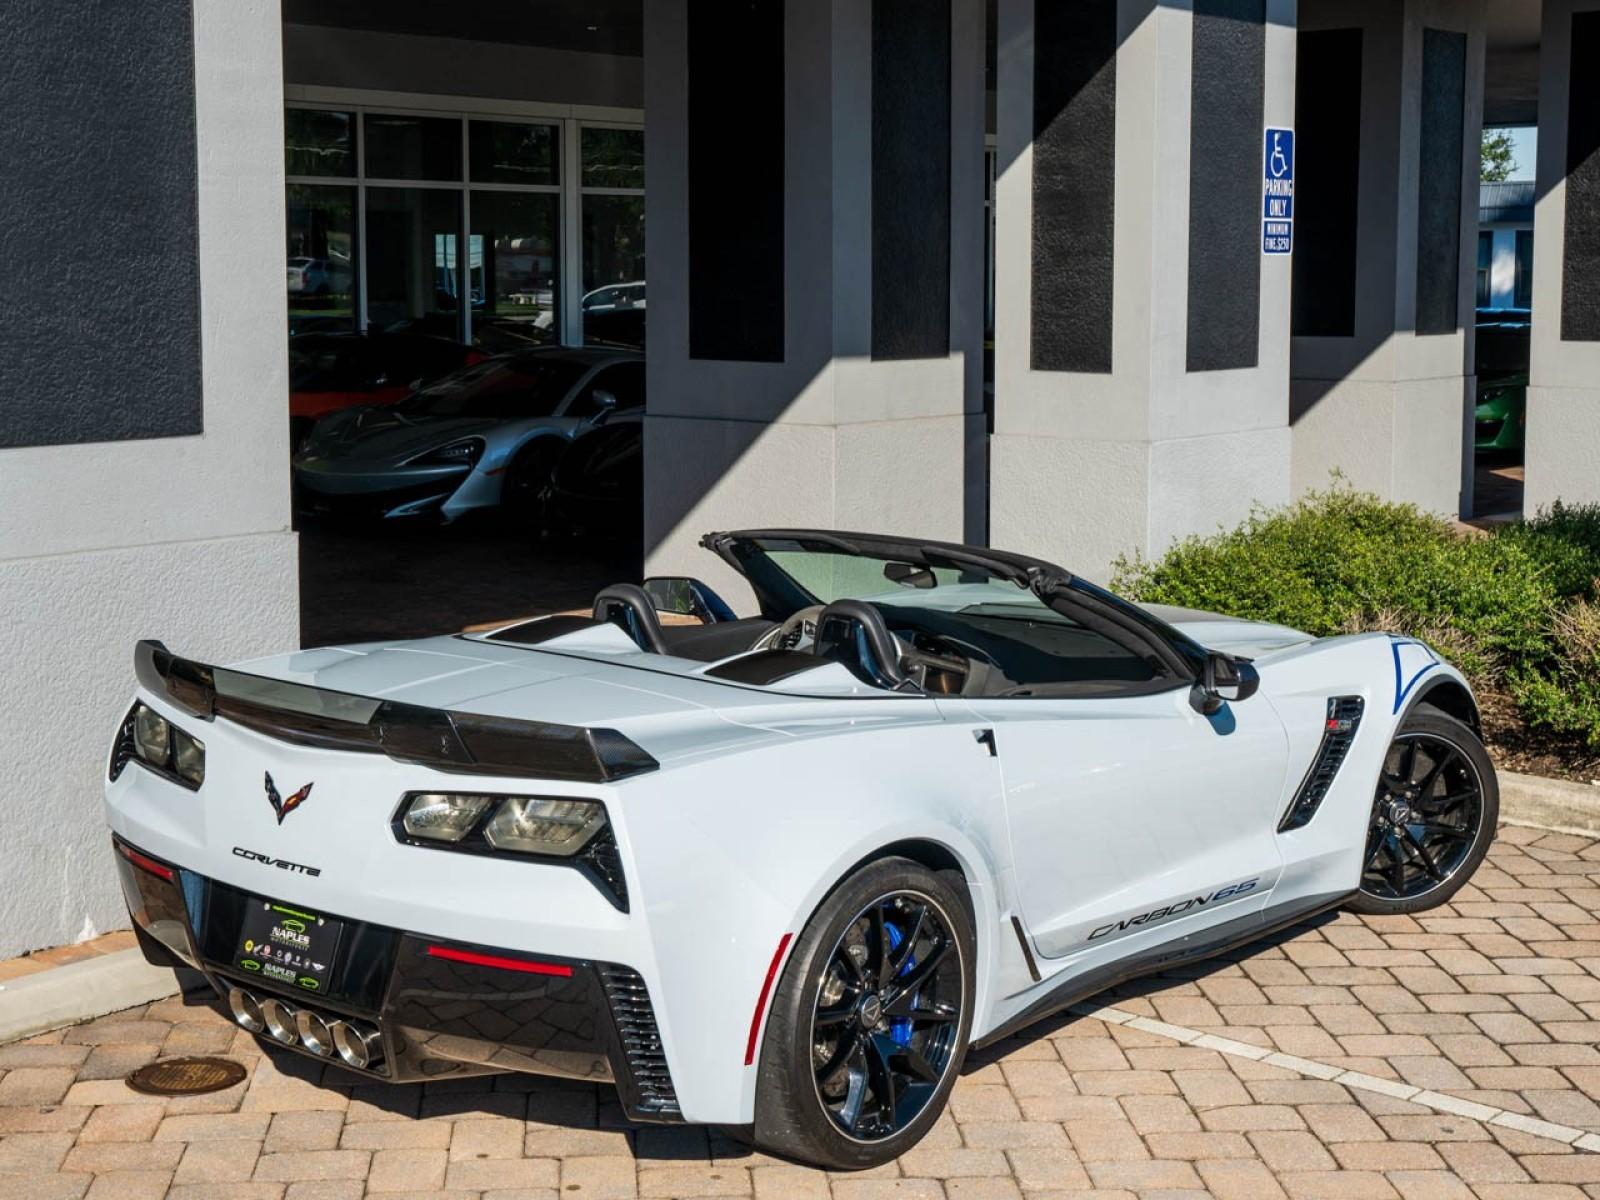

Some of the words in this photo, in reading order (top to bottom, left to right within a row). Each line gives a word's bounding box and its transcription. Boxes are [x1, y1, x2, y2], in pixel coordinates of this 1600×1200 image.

[1264, 178, 1292, 196] PARKING
[1269, 199, 1287, 216] ONLY
[232, 846, 321, 877] CORVETTE
[271, 926, 311, 945] NAPLES
